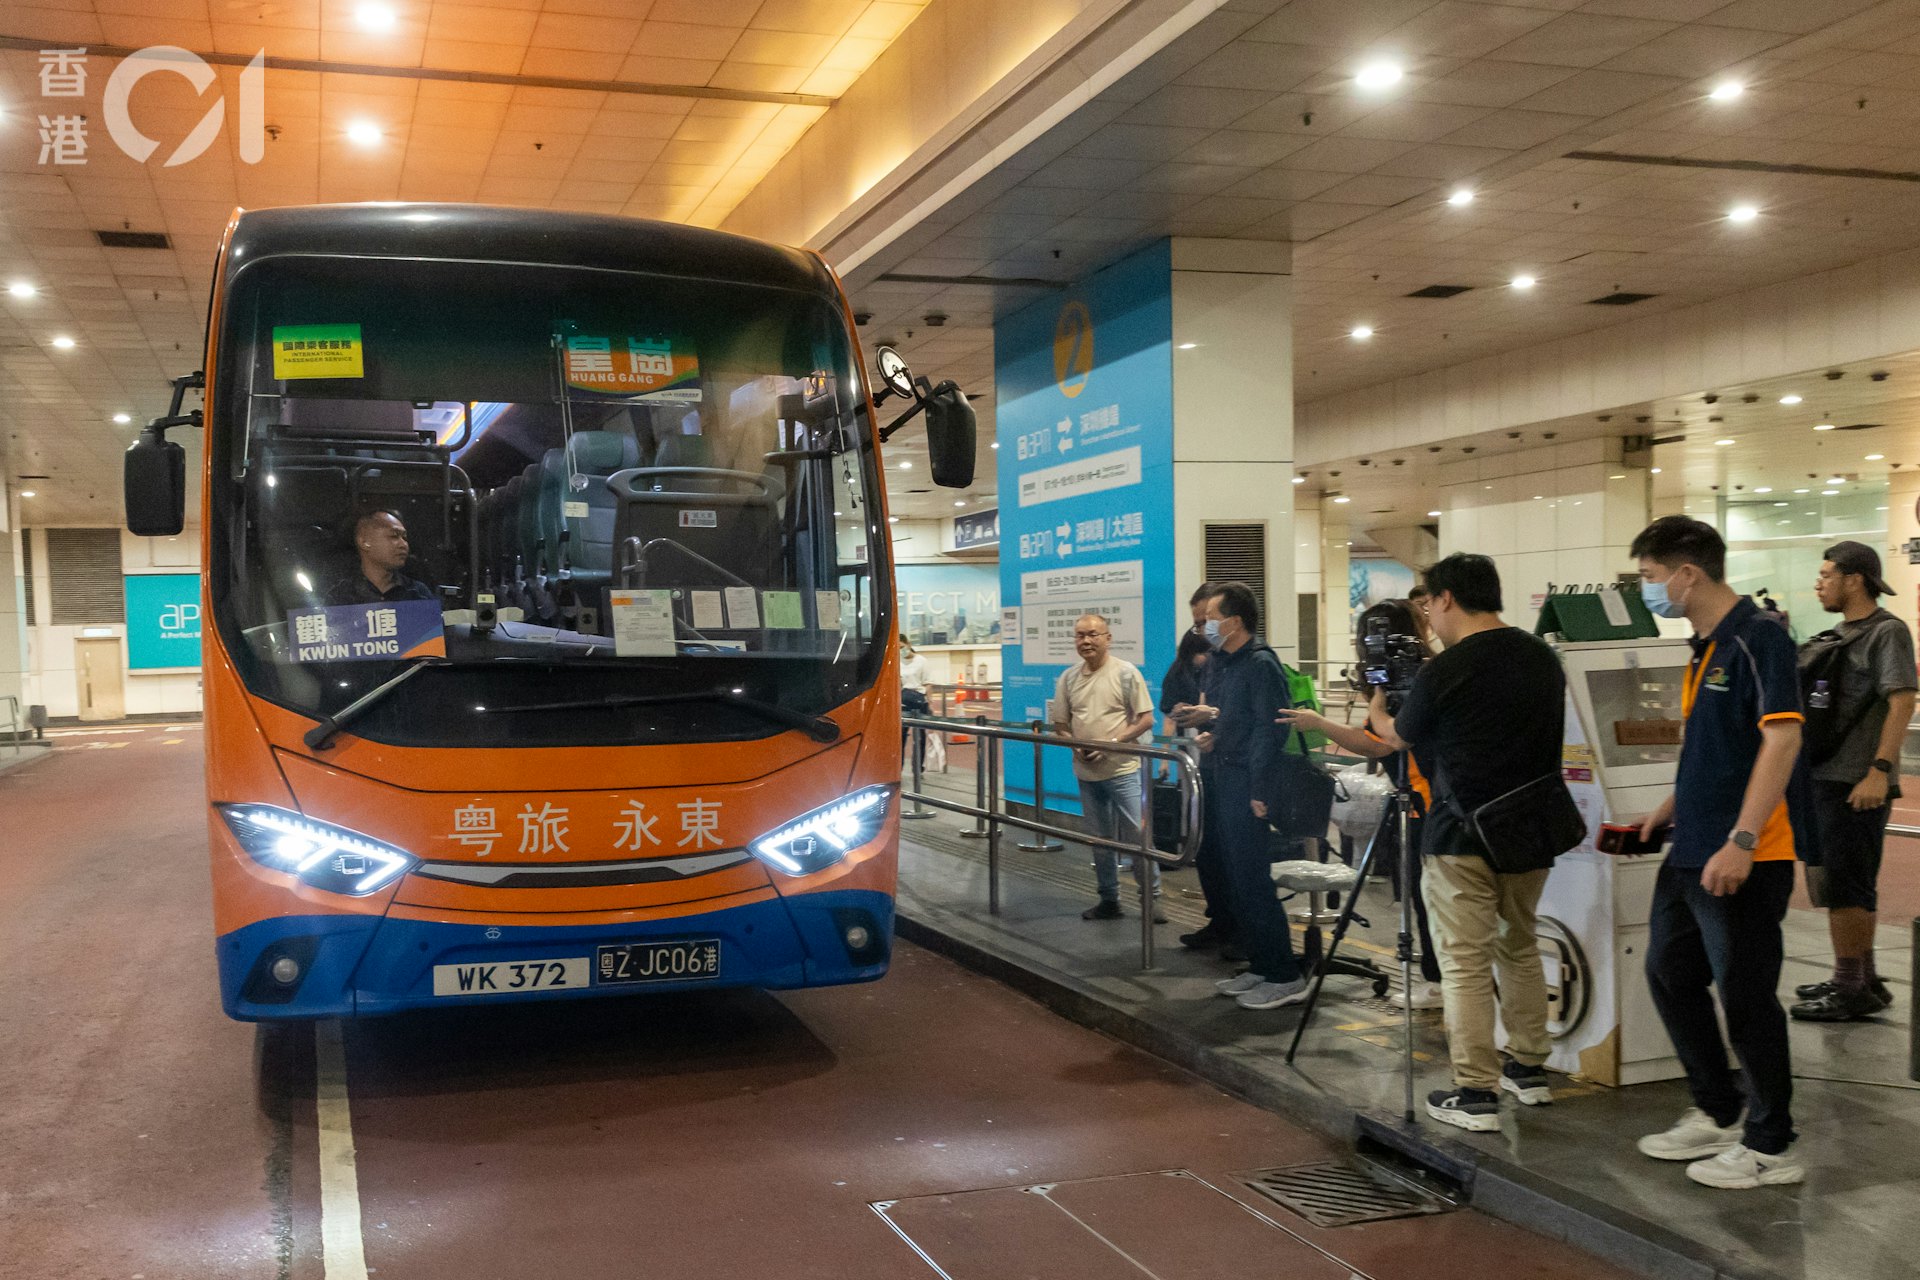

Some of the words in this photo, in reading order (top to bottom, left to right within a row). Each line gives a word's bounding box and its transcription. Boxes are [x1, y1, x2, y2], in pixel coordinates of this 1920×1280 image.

[567, 335, 673, 376] 皇崗
[570, 373, 616, 383] HUANG
[619, 372, 654, 384] GANG
[295, 608, 398, 644] 觀塘
[299, 643, 350, 661] KWUN
[353, 639, 399, 656] TONG
[613, 797, 724, 850] 永東
[457, 966, 497, 991] WK
[509, 962, 566, 988] 372
